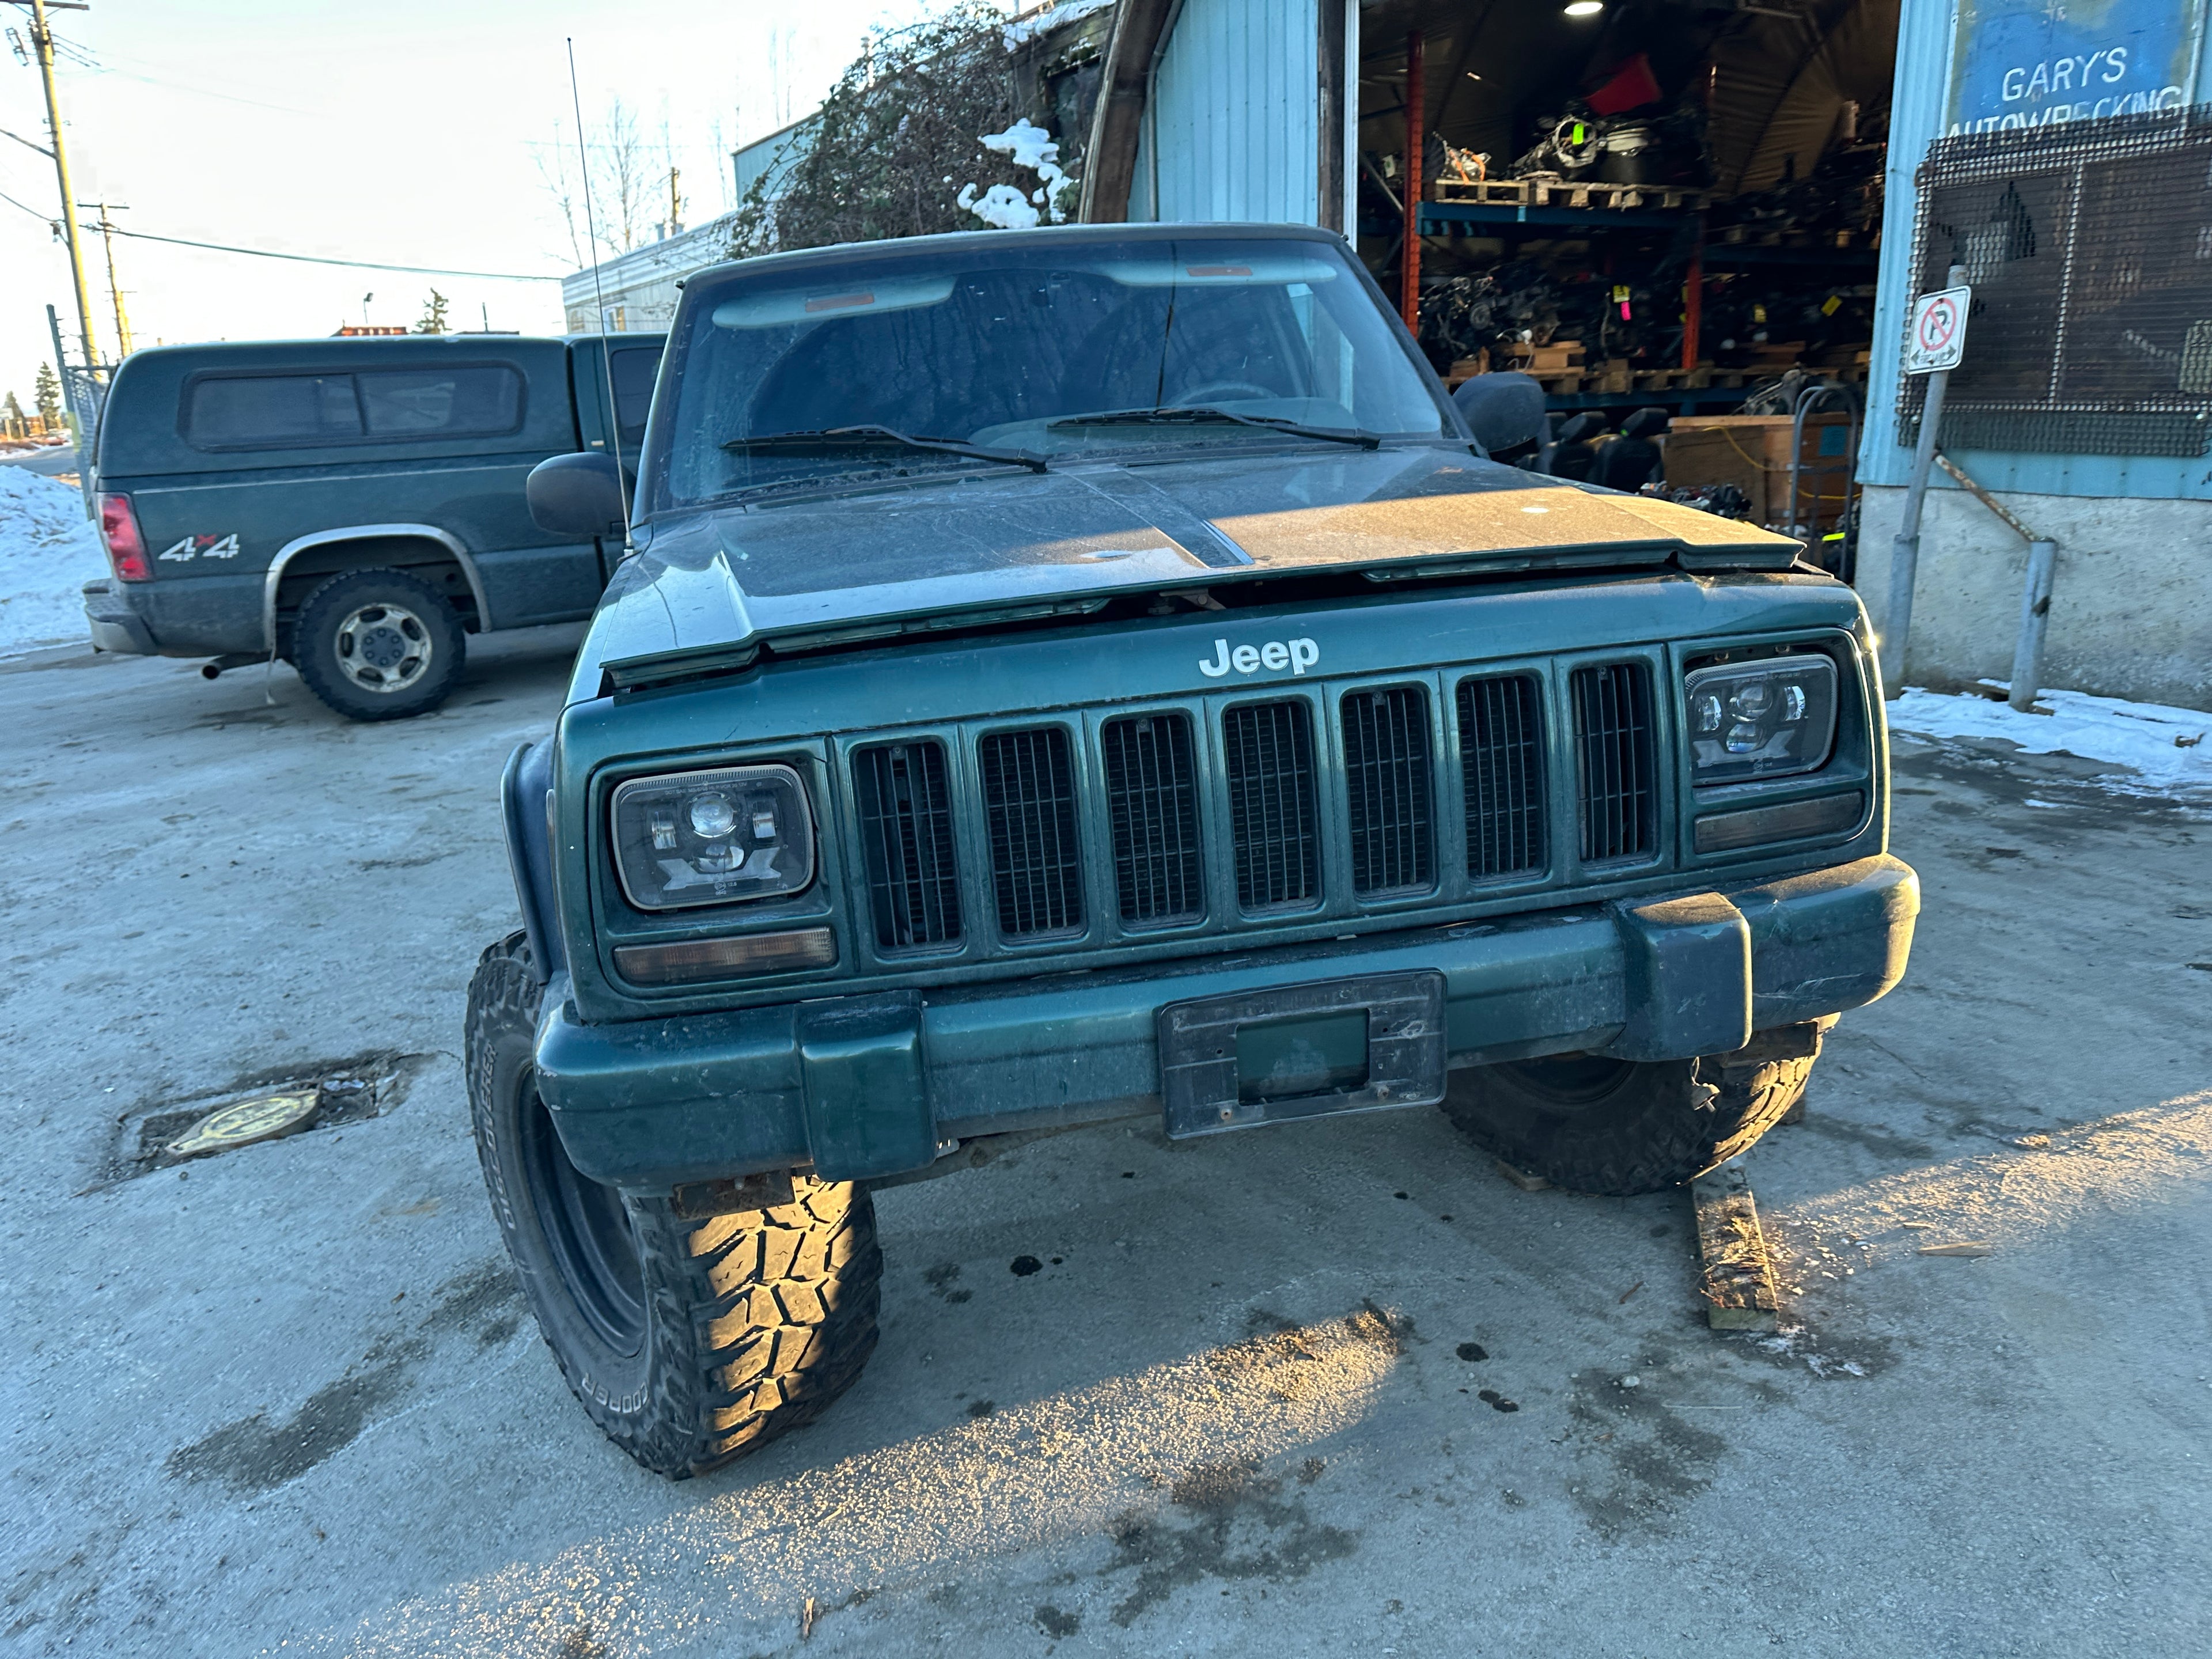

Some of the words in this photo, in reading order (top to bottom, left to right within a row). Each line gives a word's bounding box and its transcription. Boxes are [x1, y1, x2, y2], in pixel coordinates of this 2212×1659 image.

[2002, 46, 2128, 102] GARY'S
[1199, 637, 1320, 678] Jeep
[480, 1041, 516, 1230] DISCOVERER
[582, 1372, 649, 1414] COOPER
